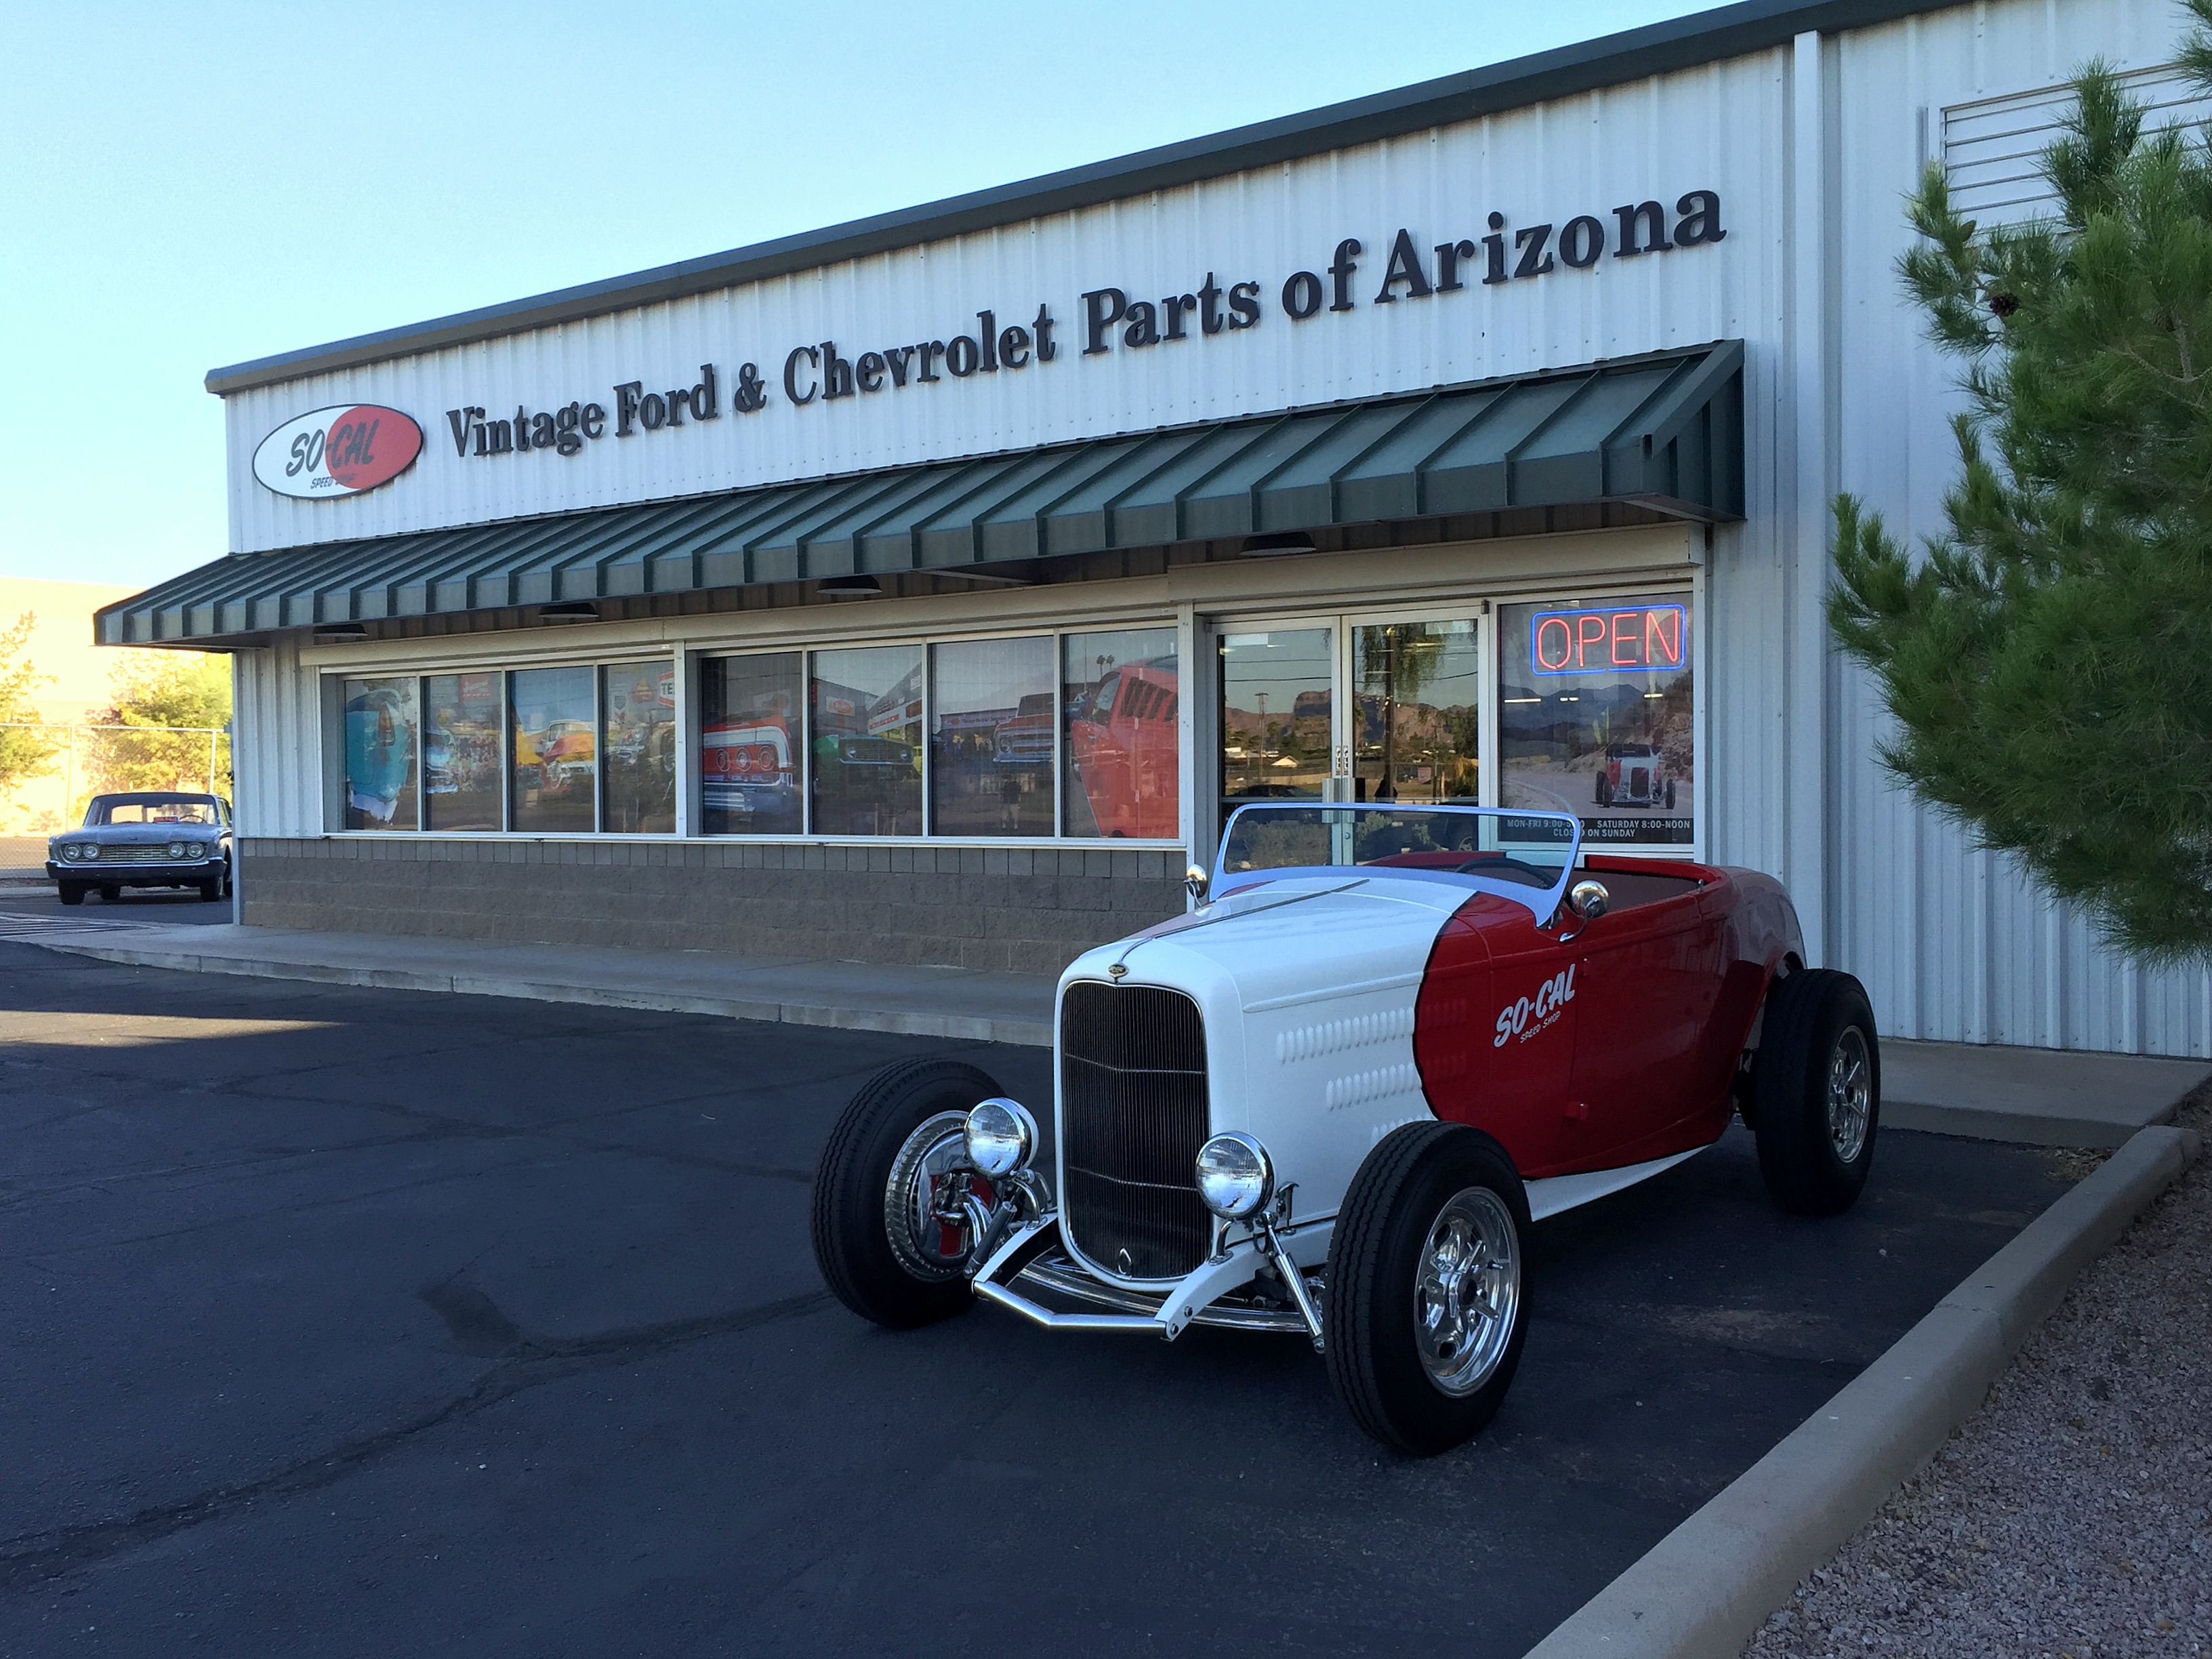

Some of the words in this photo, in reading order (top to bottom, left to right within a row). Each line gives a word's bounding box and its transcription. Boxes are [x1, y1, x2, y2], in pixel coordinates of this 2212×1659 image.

[447, 401, 605, 457] Vintage
[613, 363, 718, 437] Ford
[734, 361, 767, 413] &
[783, 303, 1055, 405] Chevrolet
[1081, 271, 1260, 354] Parts
[1282, 237, 1361, 320] of
[1374, 189, 1727, 304] Arizona
[285, 418, 380, 477] SO-CAL
[310, 476, 333, 489] SPEED
[1537, 609, 1679, 670] OPEN
[661, 682, 675, 695] TE
[1507, 819, 1541, 827] MON-FRI
[1553, 828, 1585, 837] CLOSD
[1587, 829, 1599, 837] ON
[1601, 829, 1636, 837] SUNDAY
[1597, 820, 1639, 828] SATURDAY
[1641, 820, 1690, 829] 8:00-NOON
[1493, 963, 1576, 1048] SO-CAL
[1519, 1024, 1542, 1044] SPEED
[1542, 1010, 1561, 1029] SHOP
